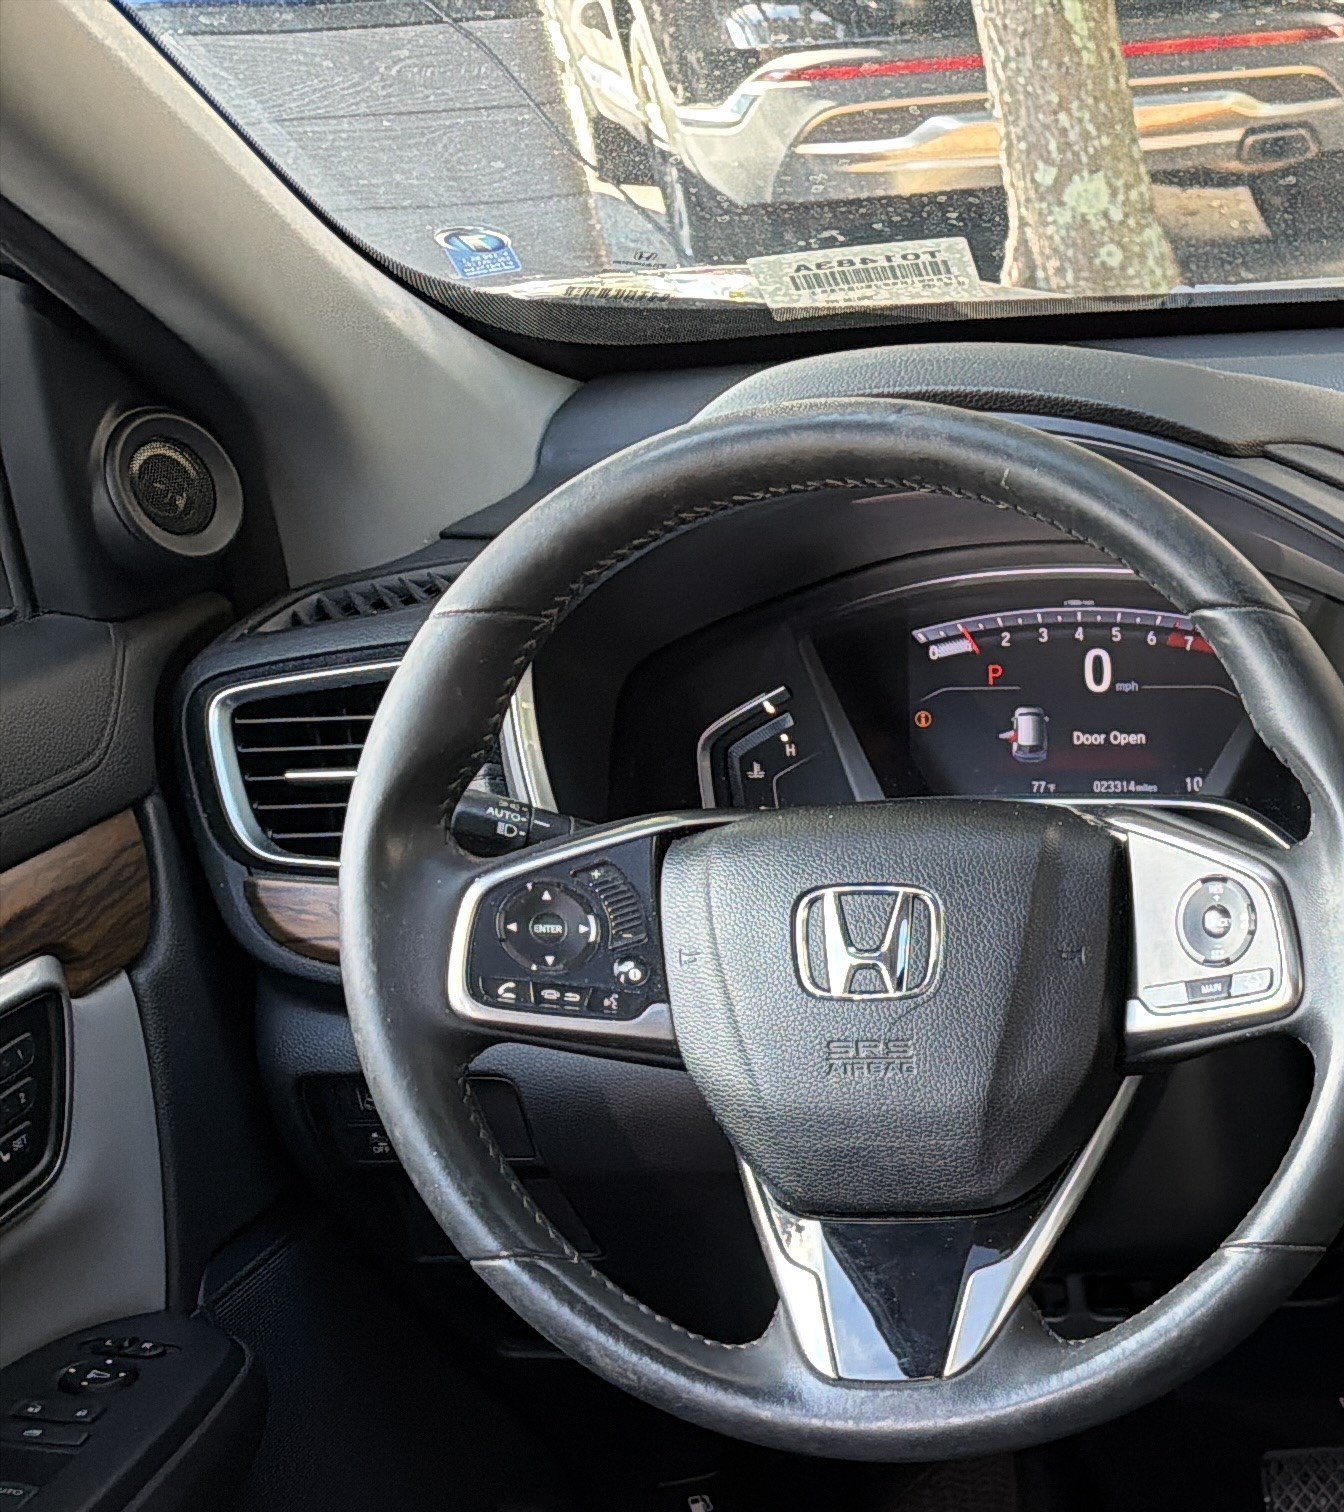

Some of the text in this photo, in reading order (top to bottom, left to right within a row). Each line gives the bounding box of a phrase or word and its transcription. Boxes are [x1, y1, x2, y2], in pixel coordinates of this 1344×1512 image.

[1001, 631, 1011, 647] 2
[1038, 627, 1048, 643] 3
[1075, 626, 1084, 642] 4
[1111, 627, 1121, 642] 5
[1147, 631, 1157, 646] 6
[1184, 636, 1194, 652] 7
[987, 664, 1003, 686] P
[1084, 647, 1139, 693] 0 mph
[1072, 731, 1147, 747] Door Open
[785, 743, 797, 757] H
[486, 806, 521, 823] AUTO
[533, 924, 563, 935] ENTER
[825, 1039, 914, 1055] SRS
